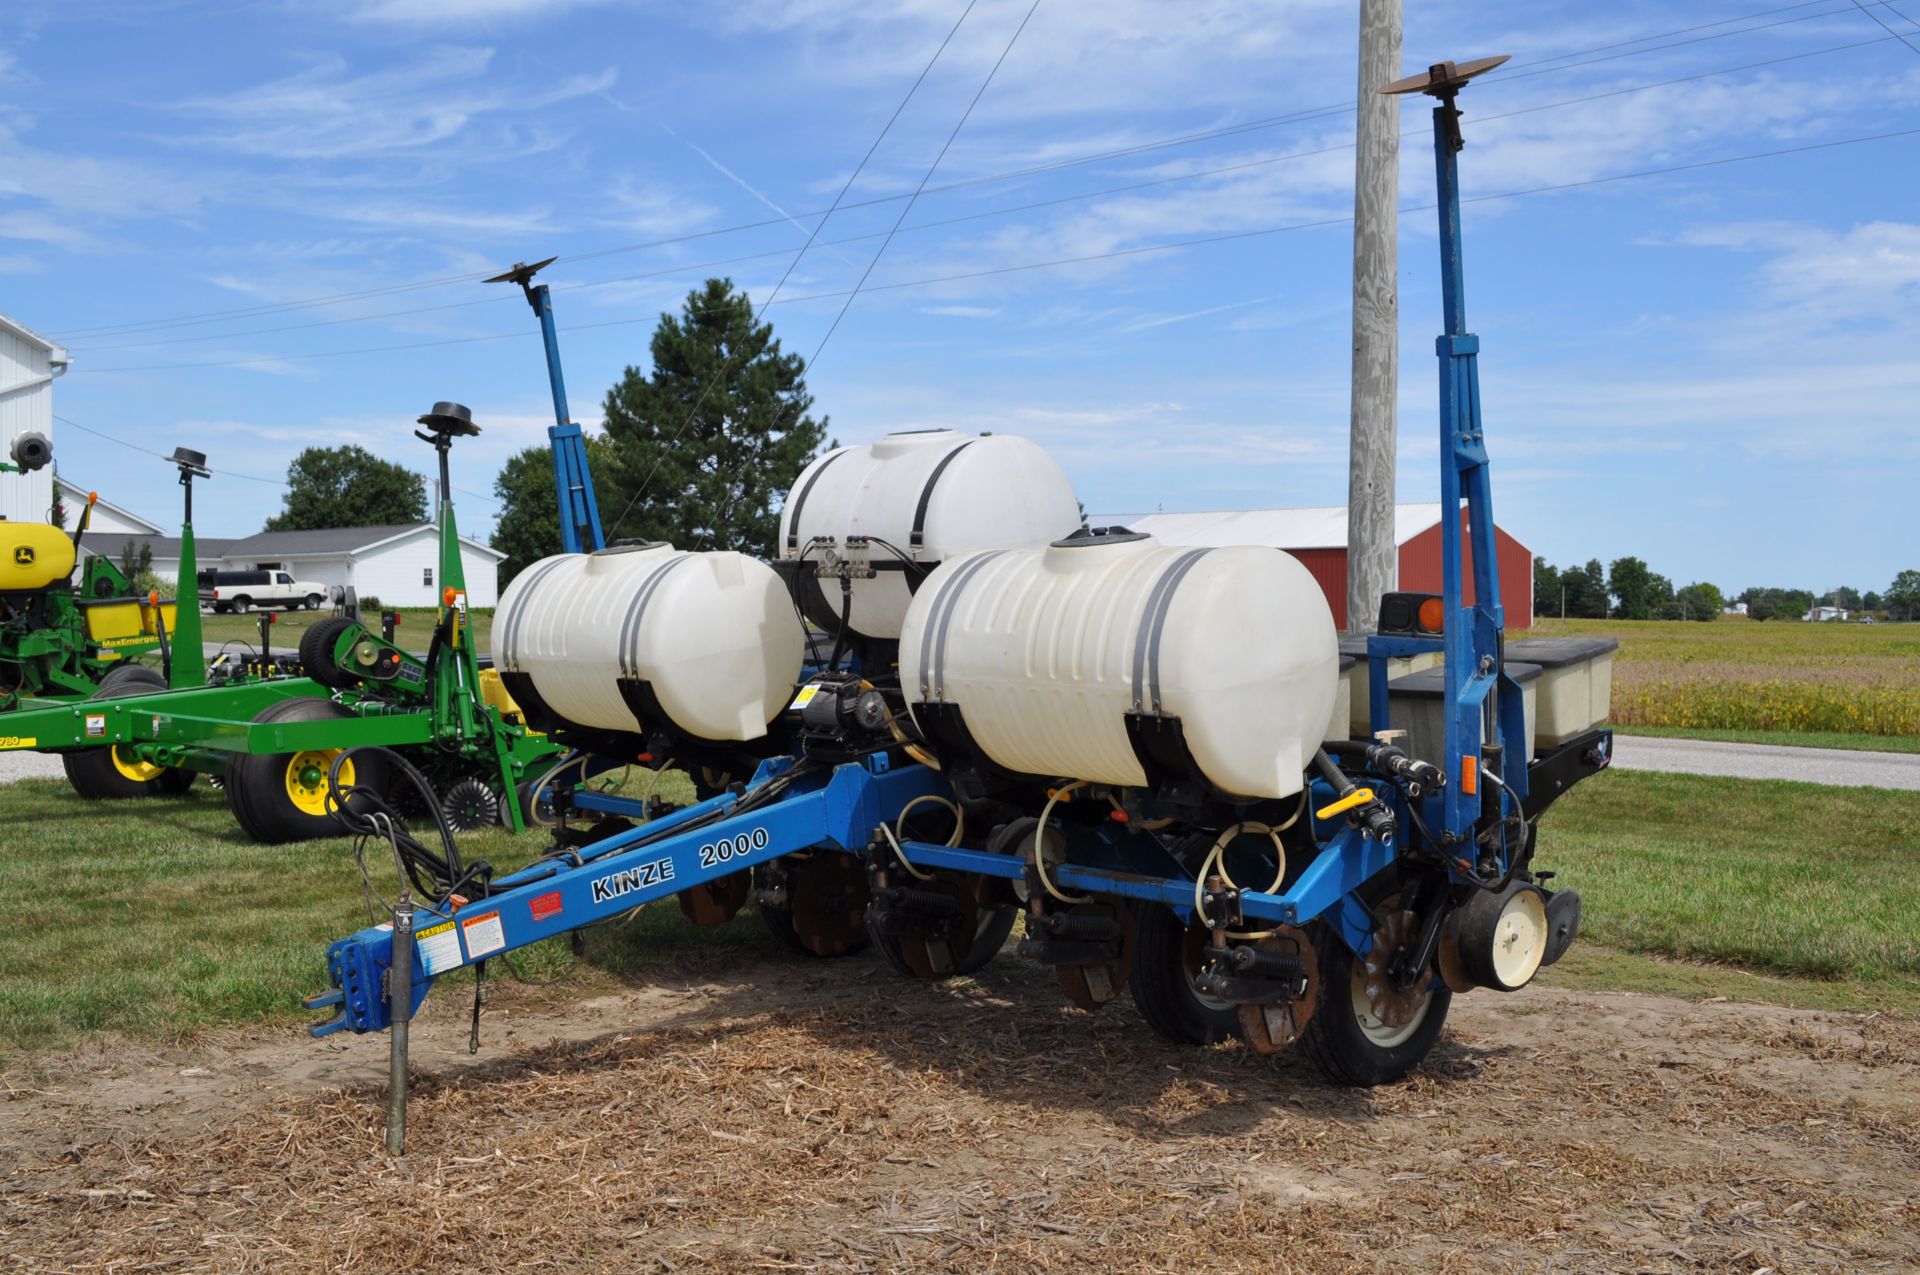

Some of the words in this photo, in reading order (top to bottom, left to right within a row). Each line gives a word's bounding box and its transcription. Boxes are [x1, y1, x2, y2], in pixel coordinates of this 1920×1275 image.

[591, 856, 676, 904] KINZE
[699, 827, 769, 869] 2000
[423, 922, 454, 936] CAUTION
